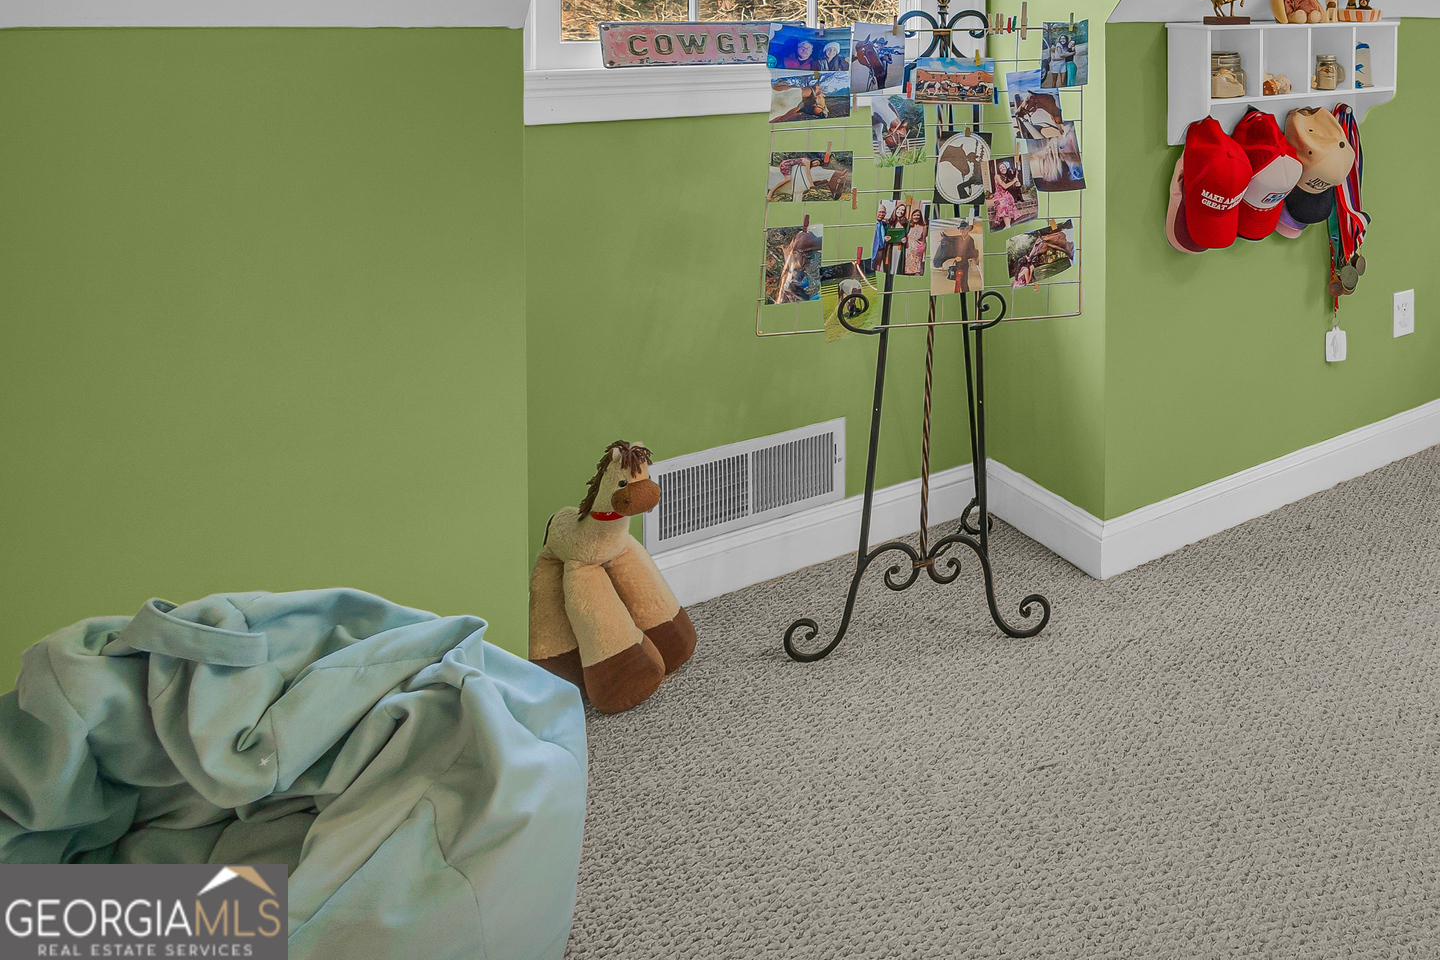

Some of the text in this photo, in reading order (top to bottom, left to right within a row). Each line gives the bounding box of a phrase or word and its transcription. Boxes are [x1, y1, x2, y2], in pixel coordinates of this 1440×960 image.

[628, 32, 769, 56] COWGIR
[1200, 188, 1225, 204] MAKE
[1201, 198, 1228, 211] GREAT
